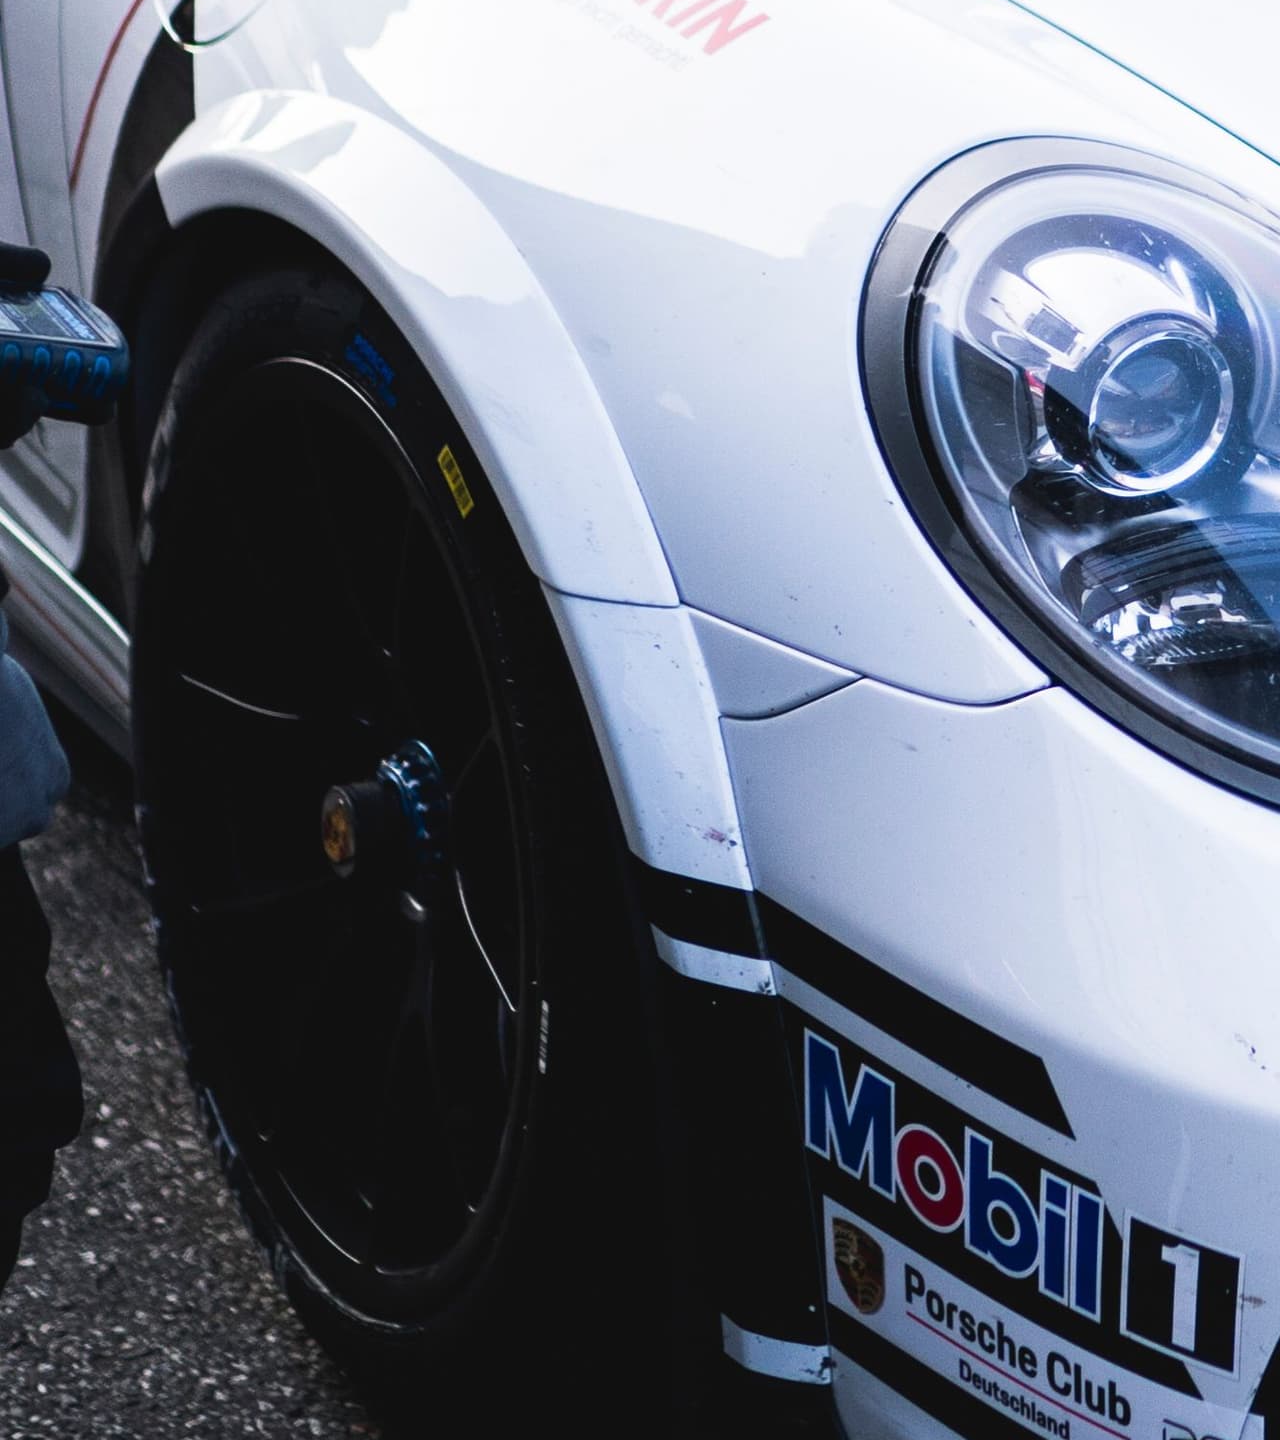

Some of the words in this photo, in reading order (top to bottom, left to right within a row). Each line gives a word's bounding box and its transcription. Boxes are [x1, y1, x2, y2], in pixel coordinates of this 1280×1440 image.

[804, 1027, 1105, 1323] Mobil
[904, 1262, 1038, 1379] Porsche
[1046, 1351, 1132, 1427] Club
